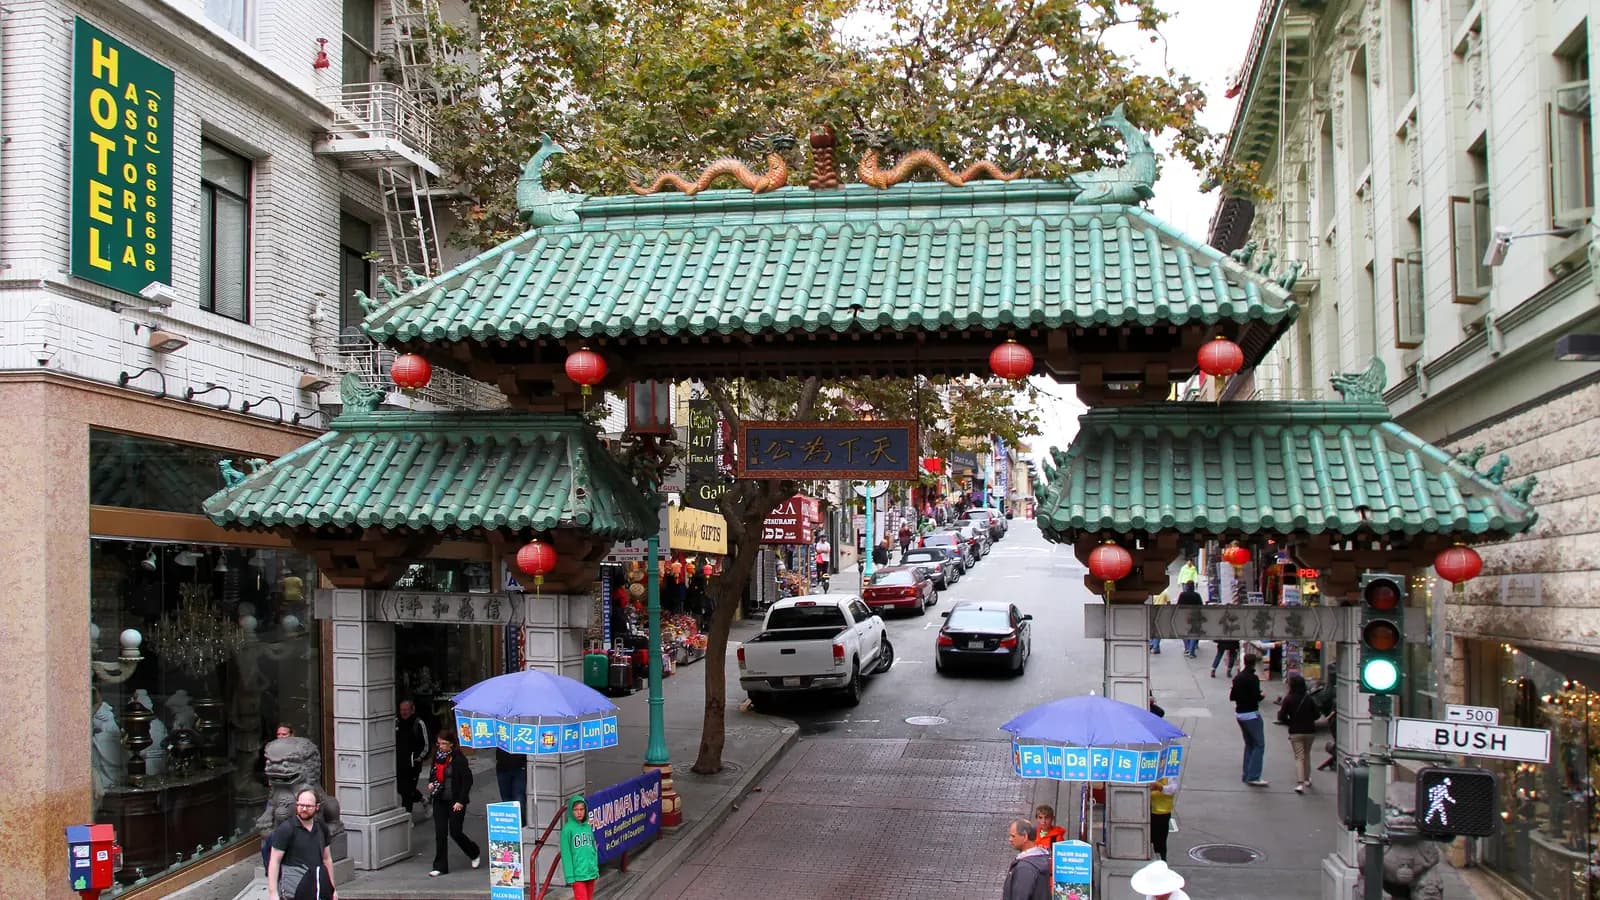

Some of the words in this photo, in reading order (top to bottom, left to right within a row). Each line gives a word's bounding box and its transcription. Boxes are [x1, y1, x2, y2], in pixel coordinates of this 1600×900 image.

[89, 38, 118, 271] HOTEL
[123, 82, 139, 267] ASTORIA
[692, 435, 712, 447] 417
[691, 454, 703, 463] Fine
[704, 455, 714, 463] Art
[701, 524, 721, 542] GIFTS
[1297, 568, 1319, 578] PEN
[1466, 709, 1493, 721] 500
[565, 729, 579, 740] Fa
[583, 726, 600, 737] Lun
[604, 723, 616, 735] Da
[1435, 728, 1507, 751] BUSH
[1023, 751, 1042, 764] Fa
[1047, 752, 1062, 765] Lun
[1067, 754, 1087, 767] Da
[1093, 754, 1108, 767] Fa
[1118, 755, 1131, 768] is
[1141, 758, 1157, 769] Great
